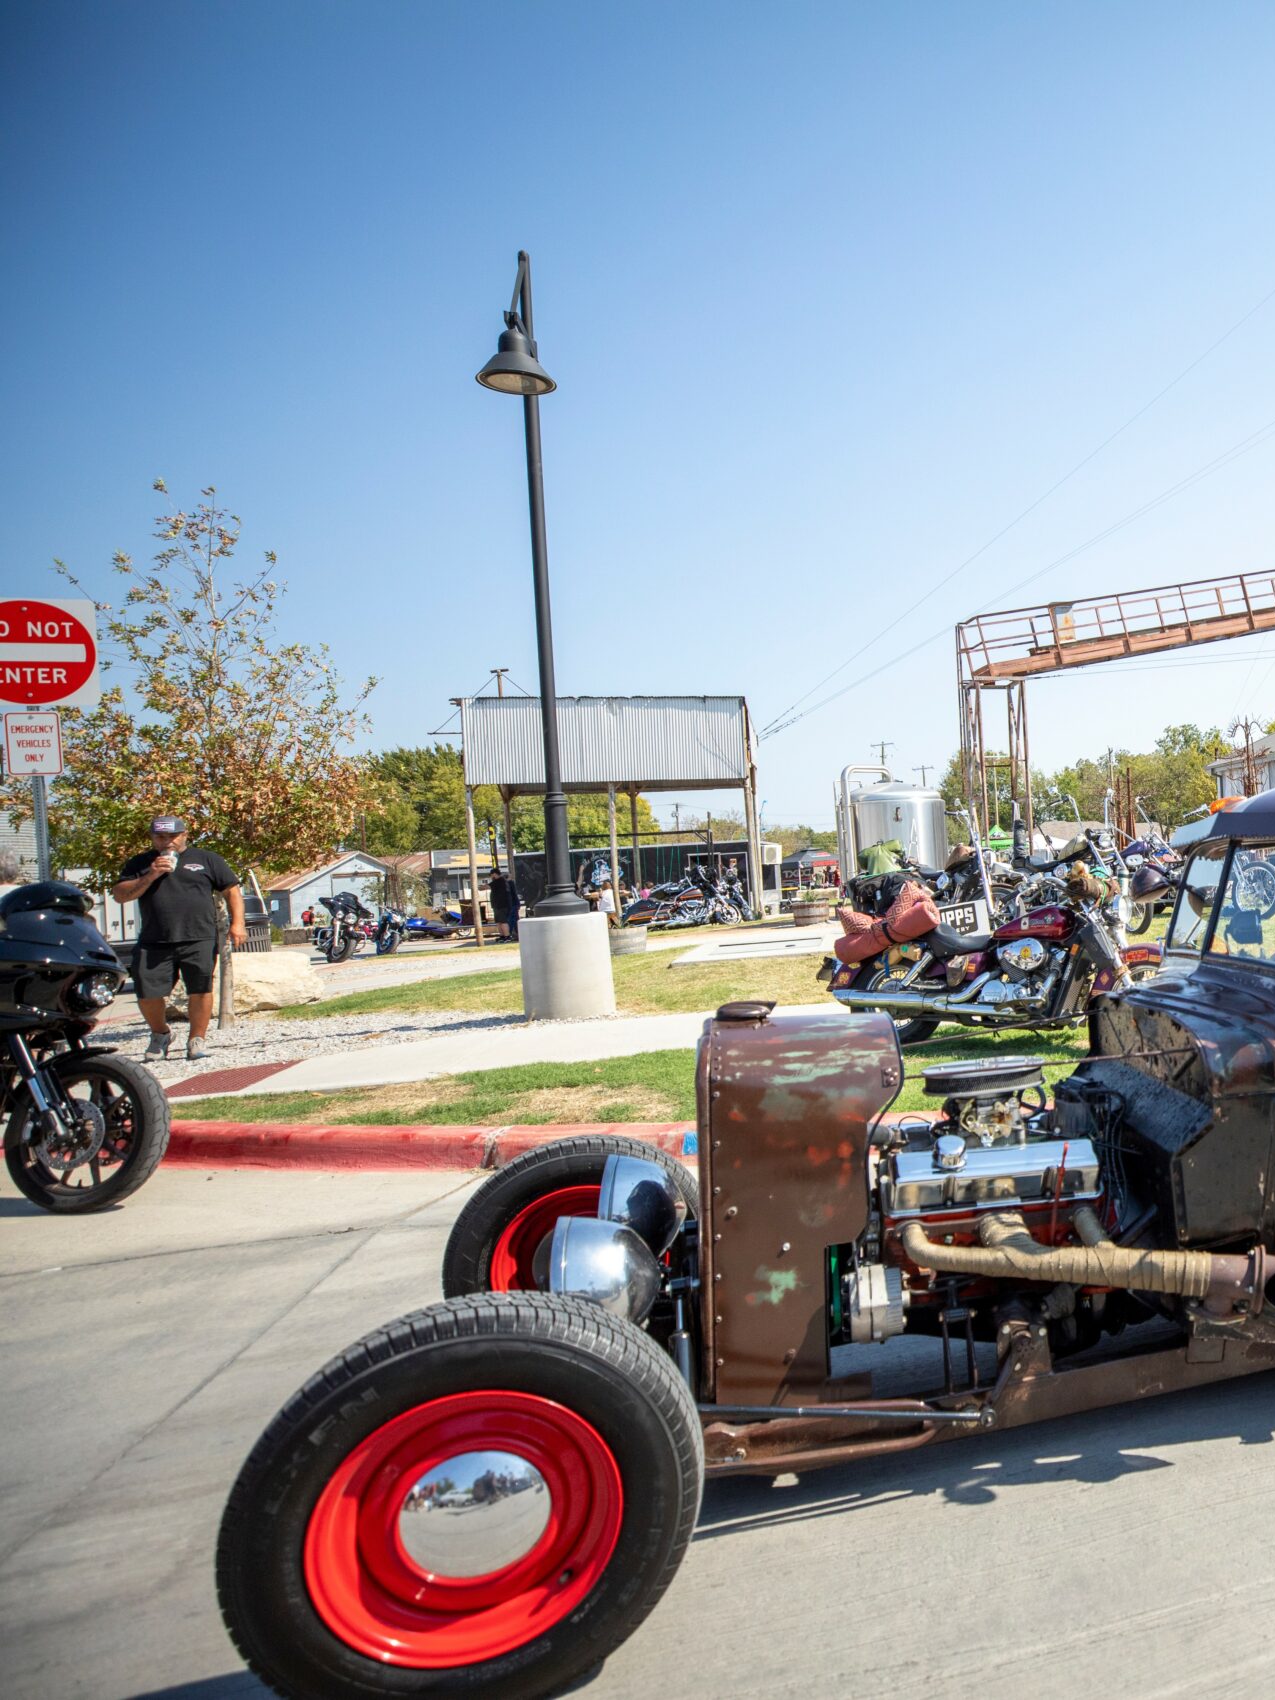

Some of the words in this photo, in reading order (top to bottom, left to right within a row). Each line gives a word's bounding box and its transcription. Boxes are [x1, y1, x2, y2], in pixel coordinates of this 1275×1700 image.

[0, 620, 10, 637] O
[27, 621, 74, 638] NOT
[10, 725, 54, 734] EMERGENCY
[16, 739, 51, 748] VEHICLES
[24, 753, 44, 762] ONLY
[941, 906, 975, 926] PPS
